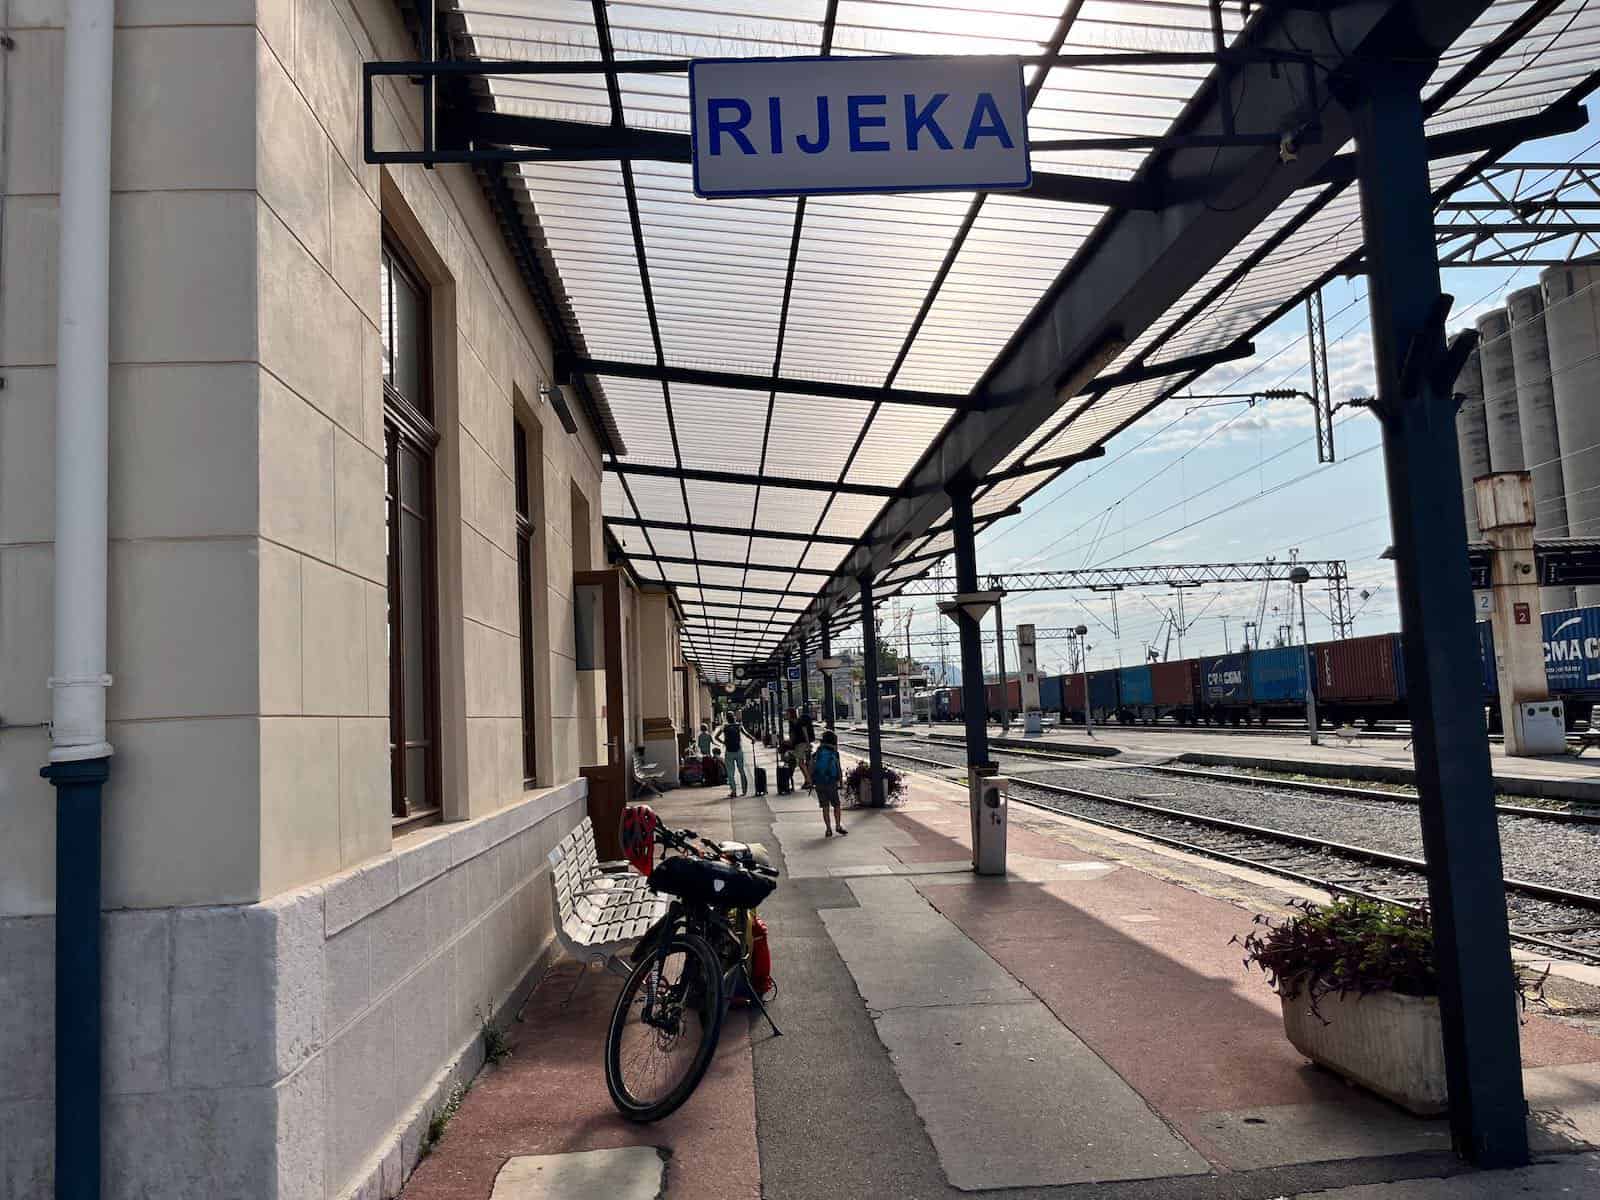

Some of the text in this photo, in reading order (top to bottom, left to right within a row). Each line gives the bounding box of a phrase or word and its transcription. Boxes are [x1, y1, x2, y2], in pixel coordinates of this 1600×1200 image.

[707, 93, 1015, 155] RIJEKA
[1480, 596, 1489, 608] 2
[1519, 612, 1527, 622] 2
